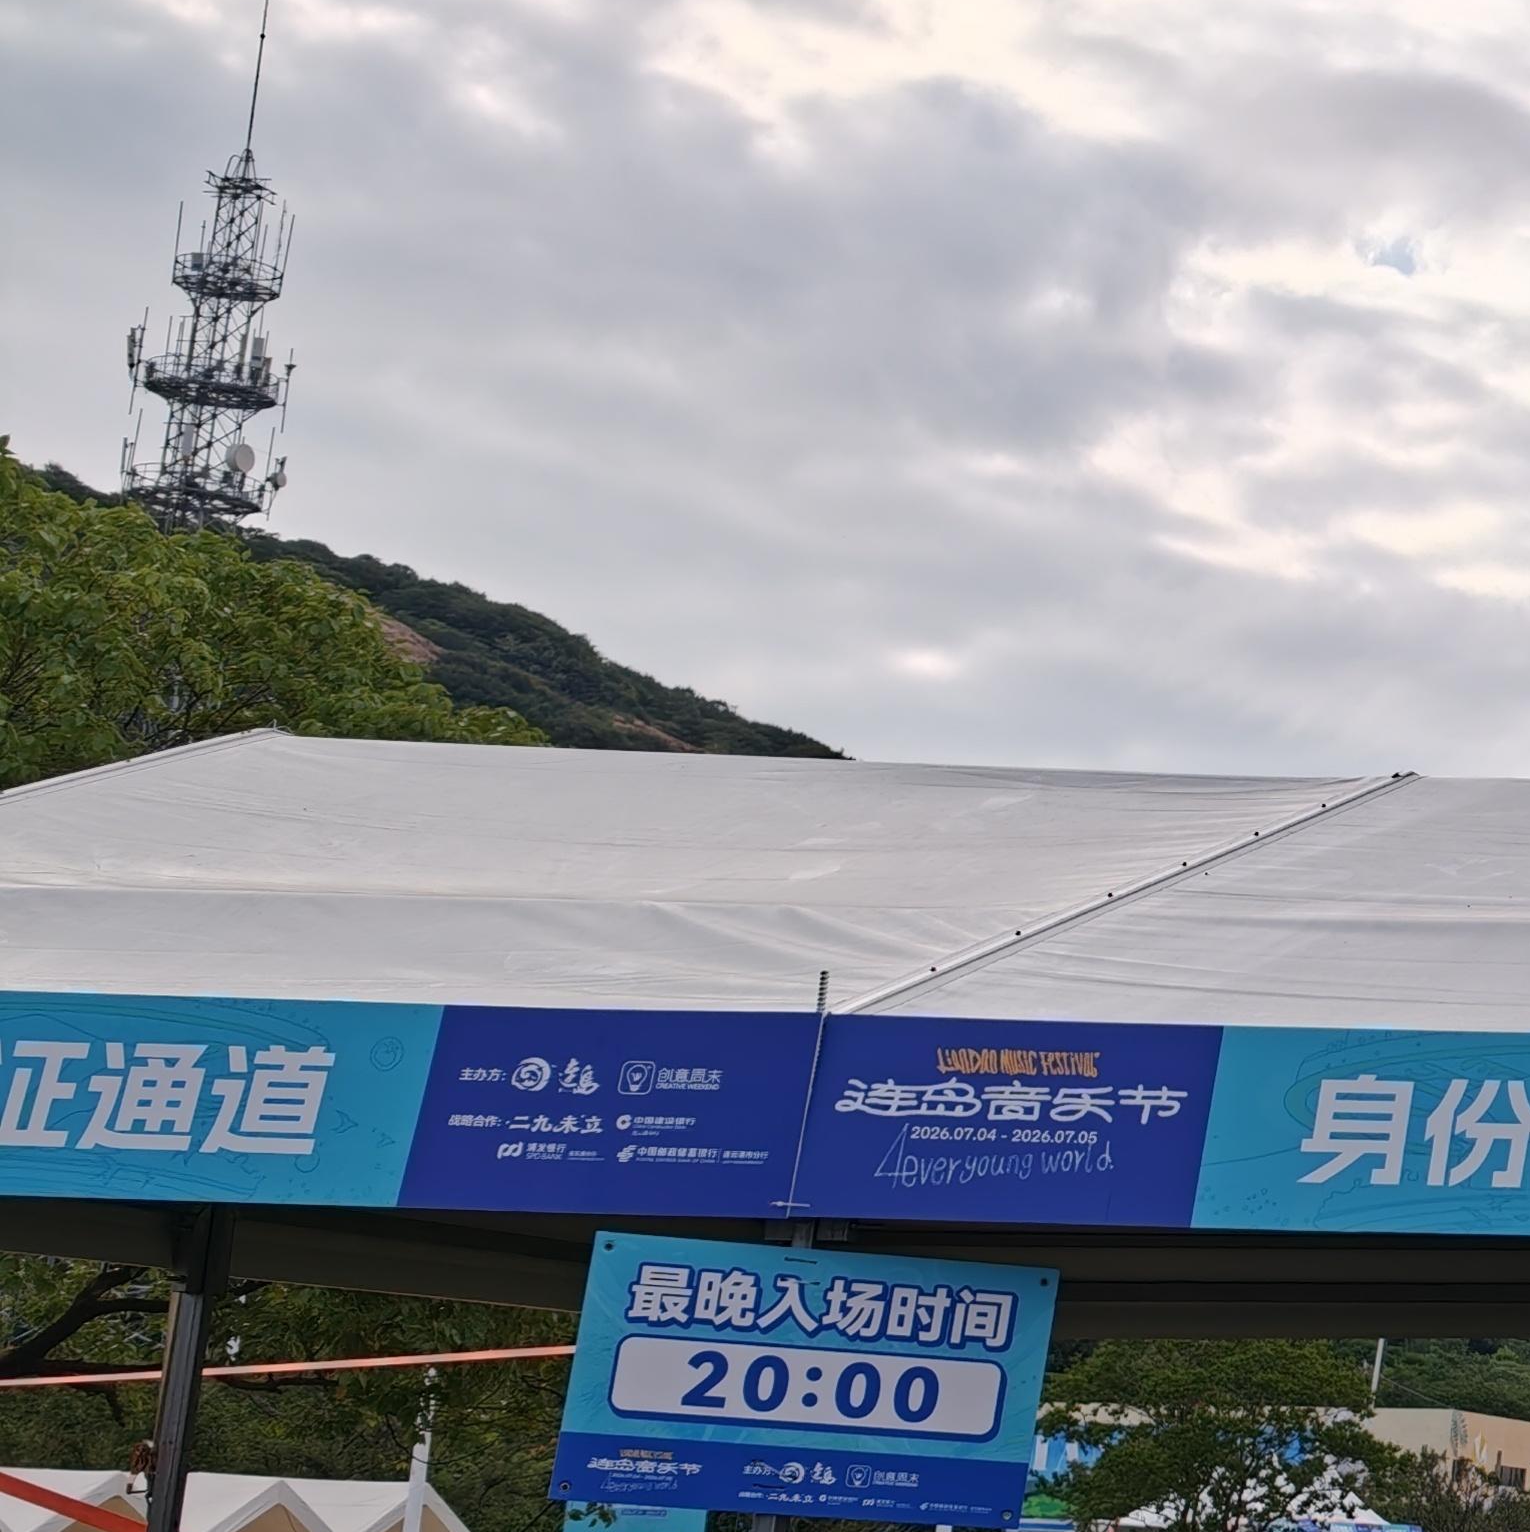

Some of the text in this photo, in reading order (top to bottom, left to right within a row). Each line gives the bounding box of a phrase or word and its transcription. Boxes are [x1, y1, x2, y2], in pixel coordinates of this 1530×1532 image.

[657, 1068, 723, 1083] 创意周末
[835, 1077, 1188, 1124] 连岛音乐节
[910, 1126, 996, 1141] 2026.07.04
[1011, 1128, 1098, 1144] 2026.07.05
[628, 1265, 1013, 1347] 最晚入场时间
[681, 1351, 939, 1423] 20:00
